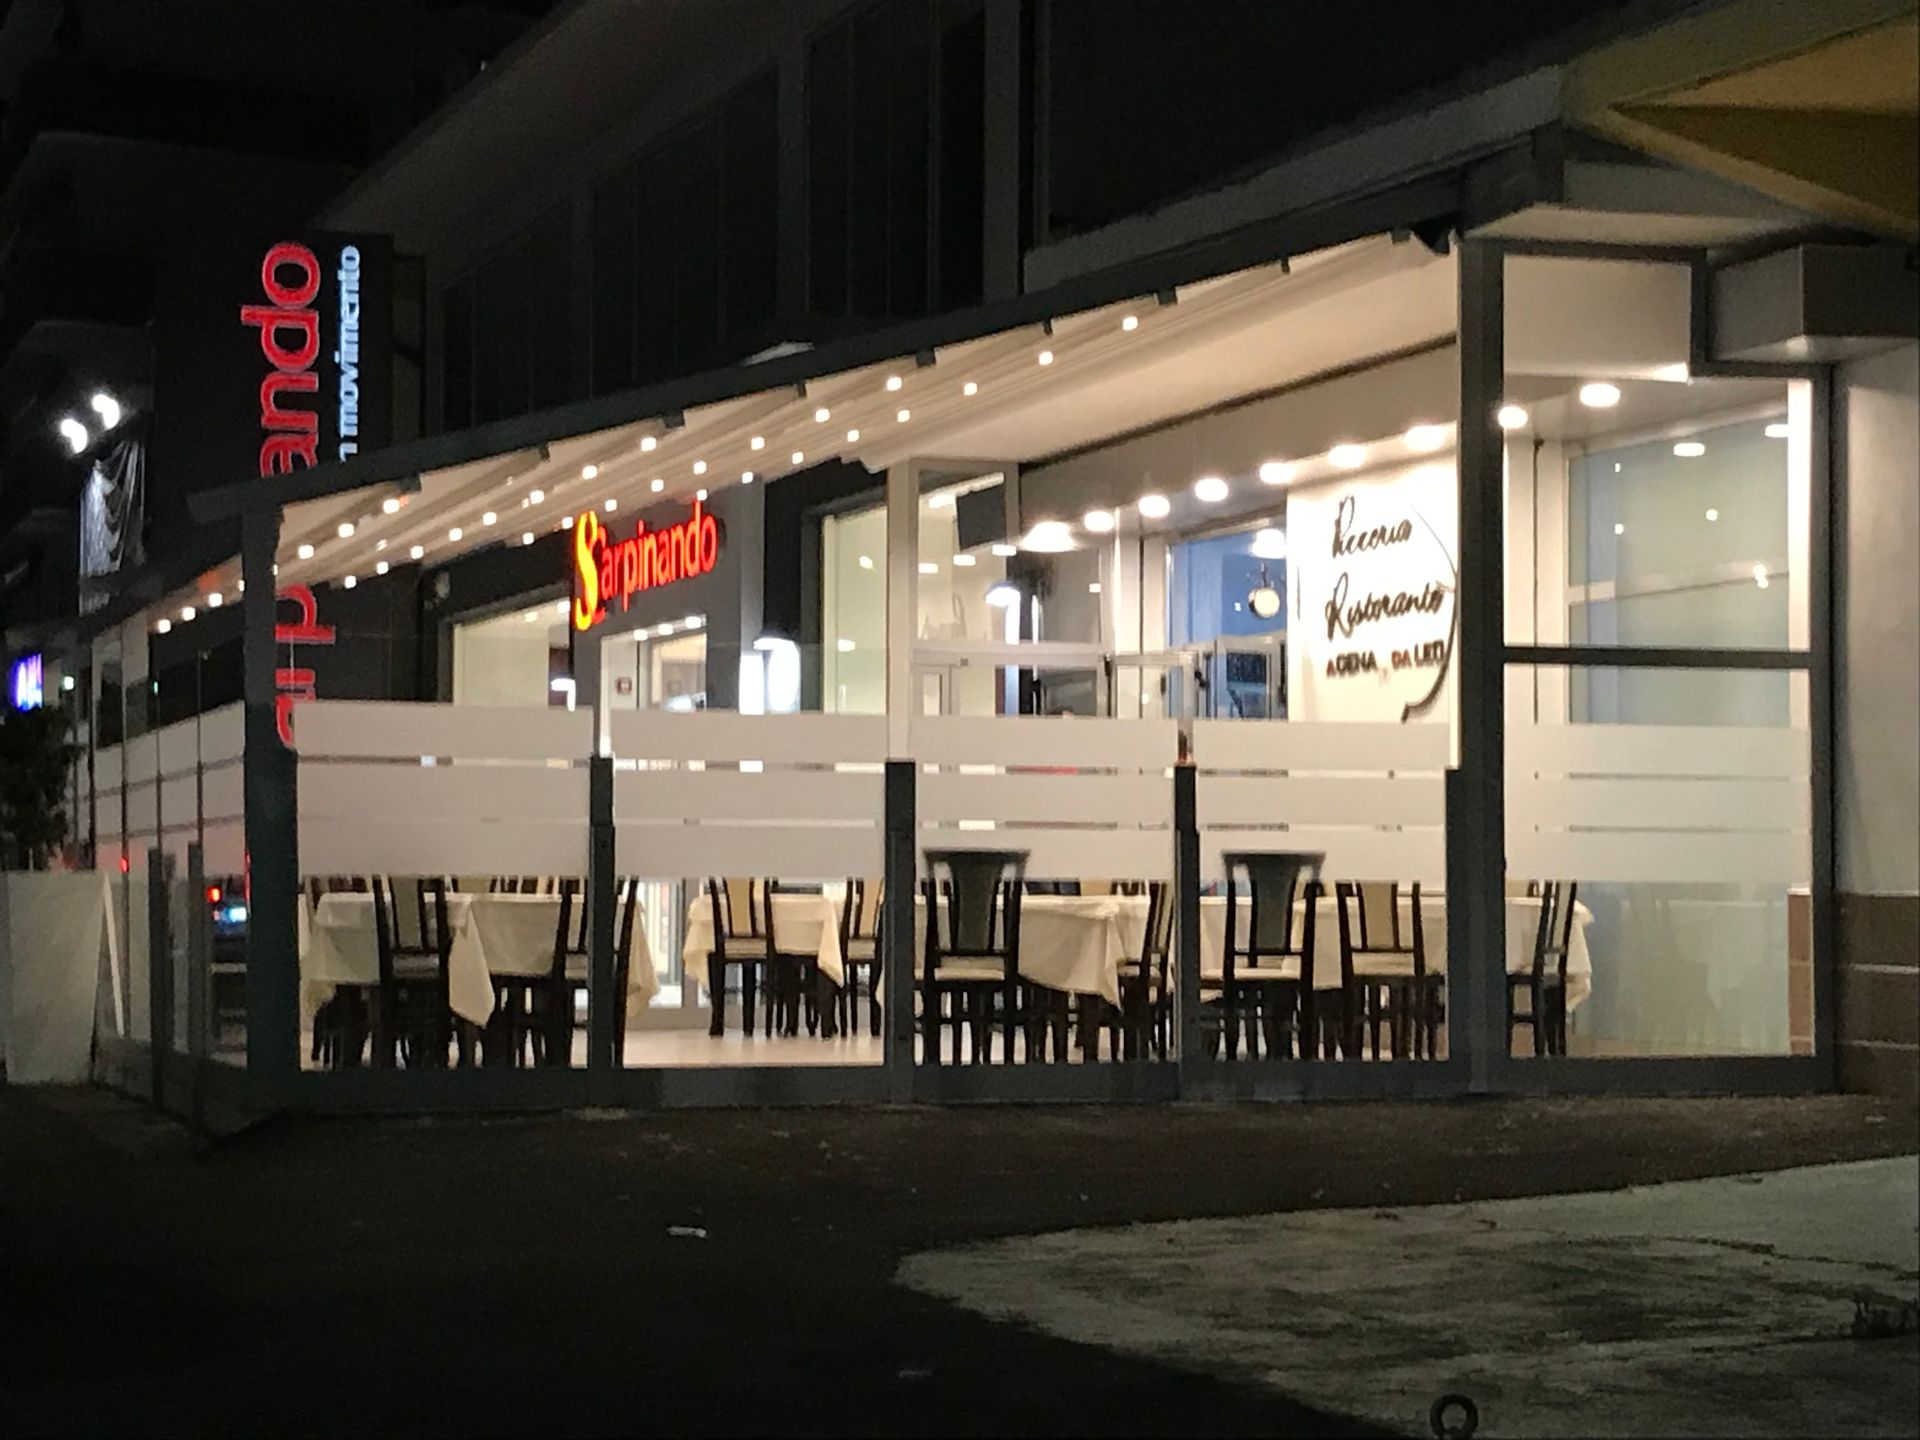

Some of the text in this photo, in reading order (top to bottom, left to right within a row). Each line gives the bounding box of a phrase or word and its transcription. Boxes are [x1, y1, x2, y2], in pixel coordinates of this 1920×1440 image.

[334, 245, 361, 439] movimento
[574, 501, 718, 631] Sarpinando
[1325, 571, 1444, 641] Ristorante
